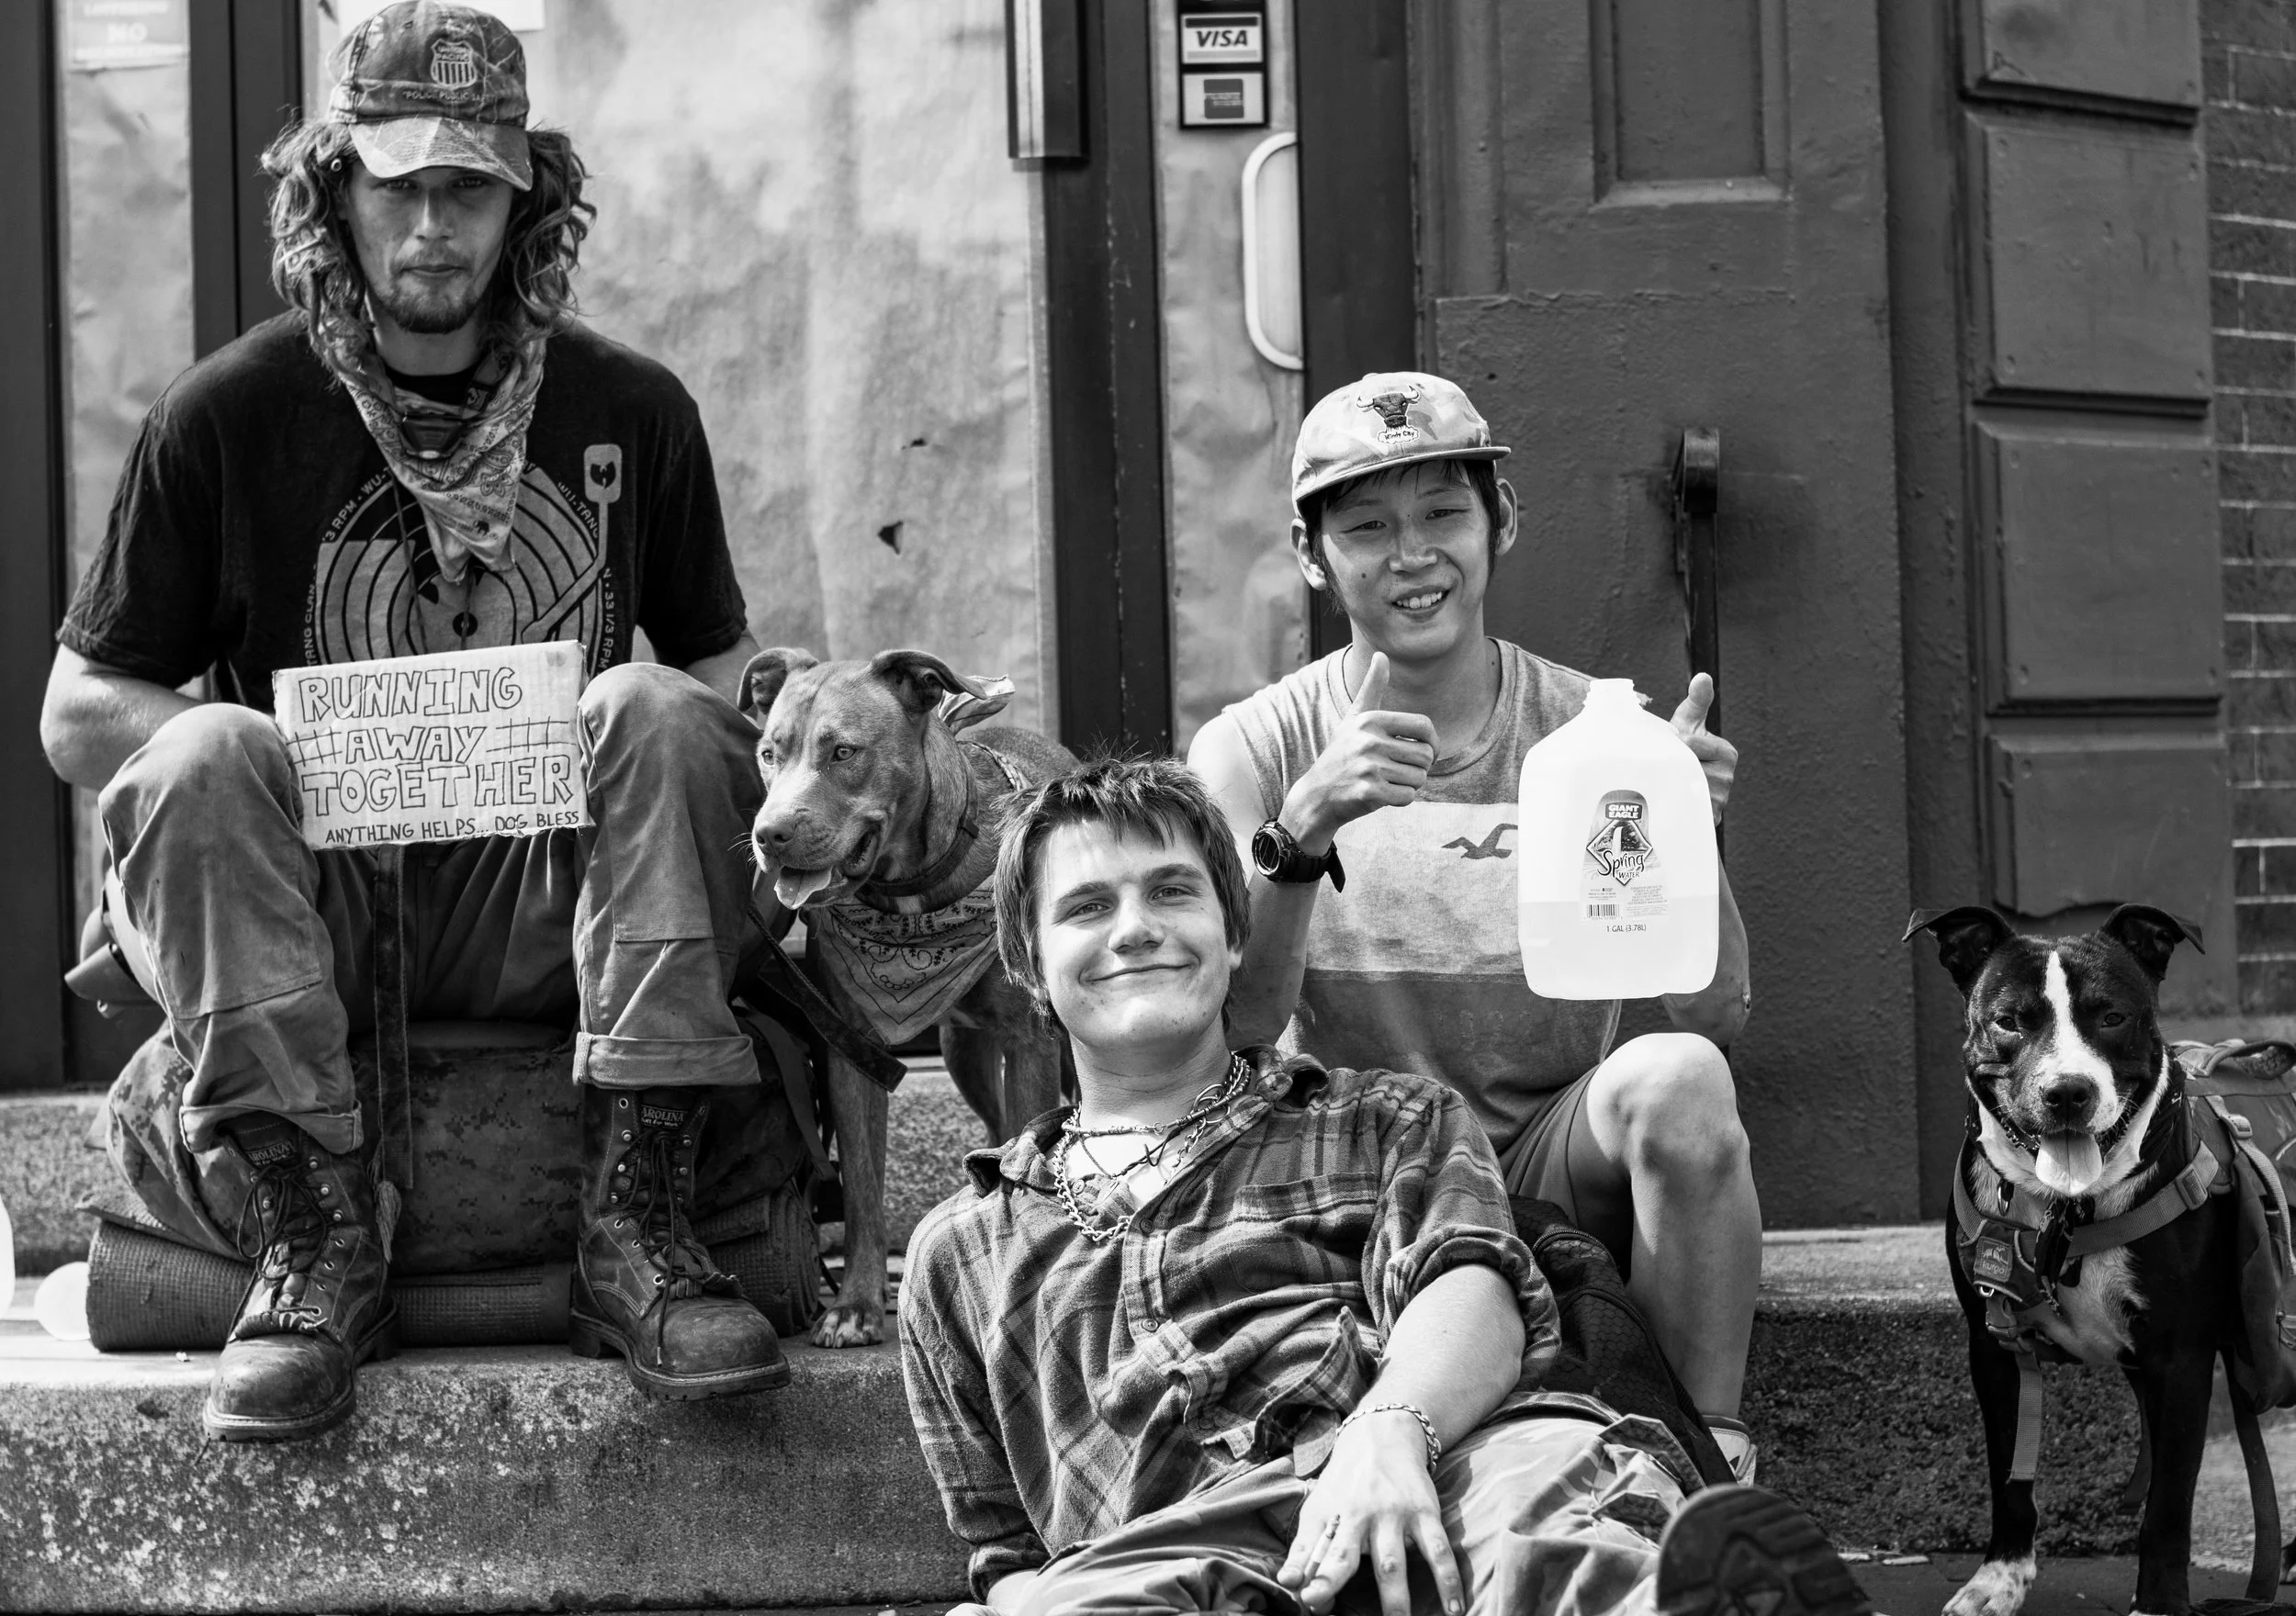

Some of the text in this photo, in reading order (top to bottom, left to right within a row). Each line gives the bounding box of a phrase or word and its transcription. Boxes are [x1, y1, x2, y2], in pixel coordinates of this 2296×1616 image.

[1197, 29, 1248, 47] VISA
[332, 499, 356, 530] RPM
[598, 591, 615, 668] 33 1/3 RPM
[298, 667, 523, 723] RUNNING
[346, 725, 488, 764] AWAY
[301, 754, 574, 817] TOGETHER
[1608, 804, 1639, 813] GIANT
[1608, 811, 1638, 819] EAGLE
[325, 823, 414, 844] ANYTHING
[495, 814, 528, 831] DOG
[536, 811, 580, 828] BLESS
[1597, 849, 1645, 878] Spring
[1612, 925, 1624, 933] GAL
[1626, 924, 1647, 933] (3.78L)
[641, 1106, 684, 1122] AROLINA
[1982, 1261, 2005, 1274] kurgo
